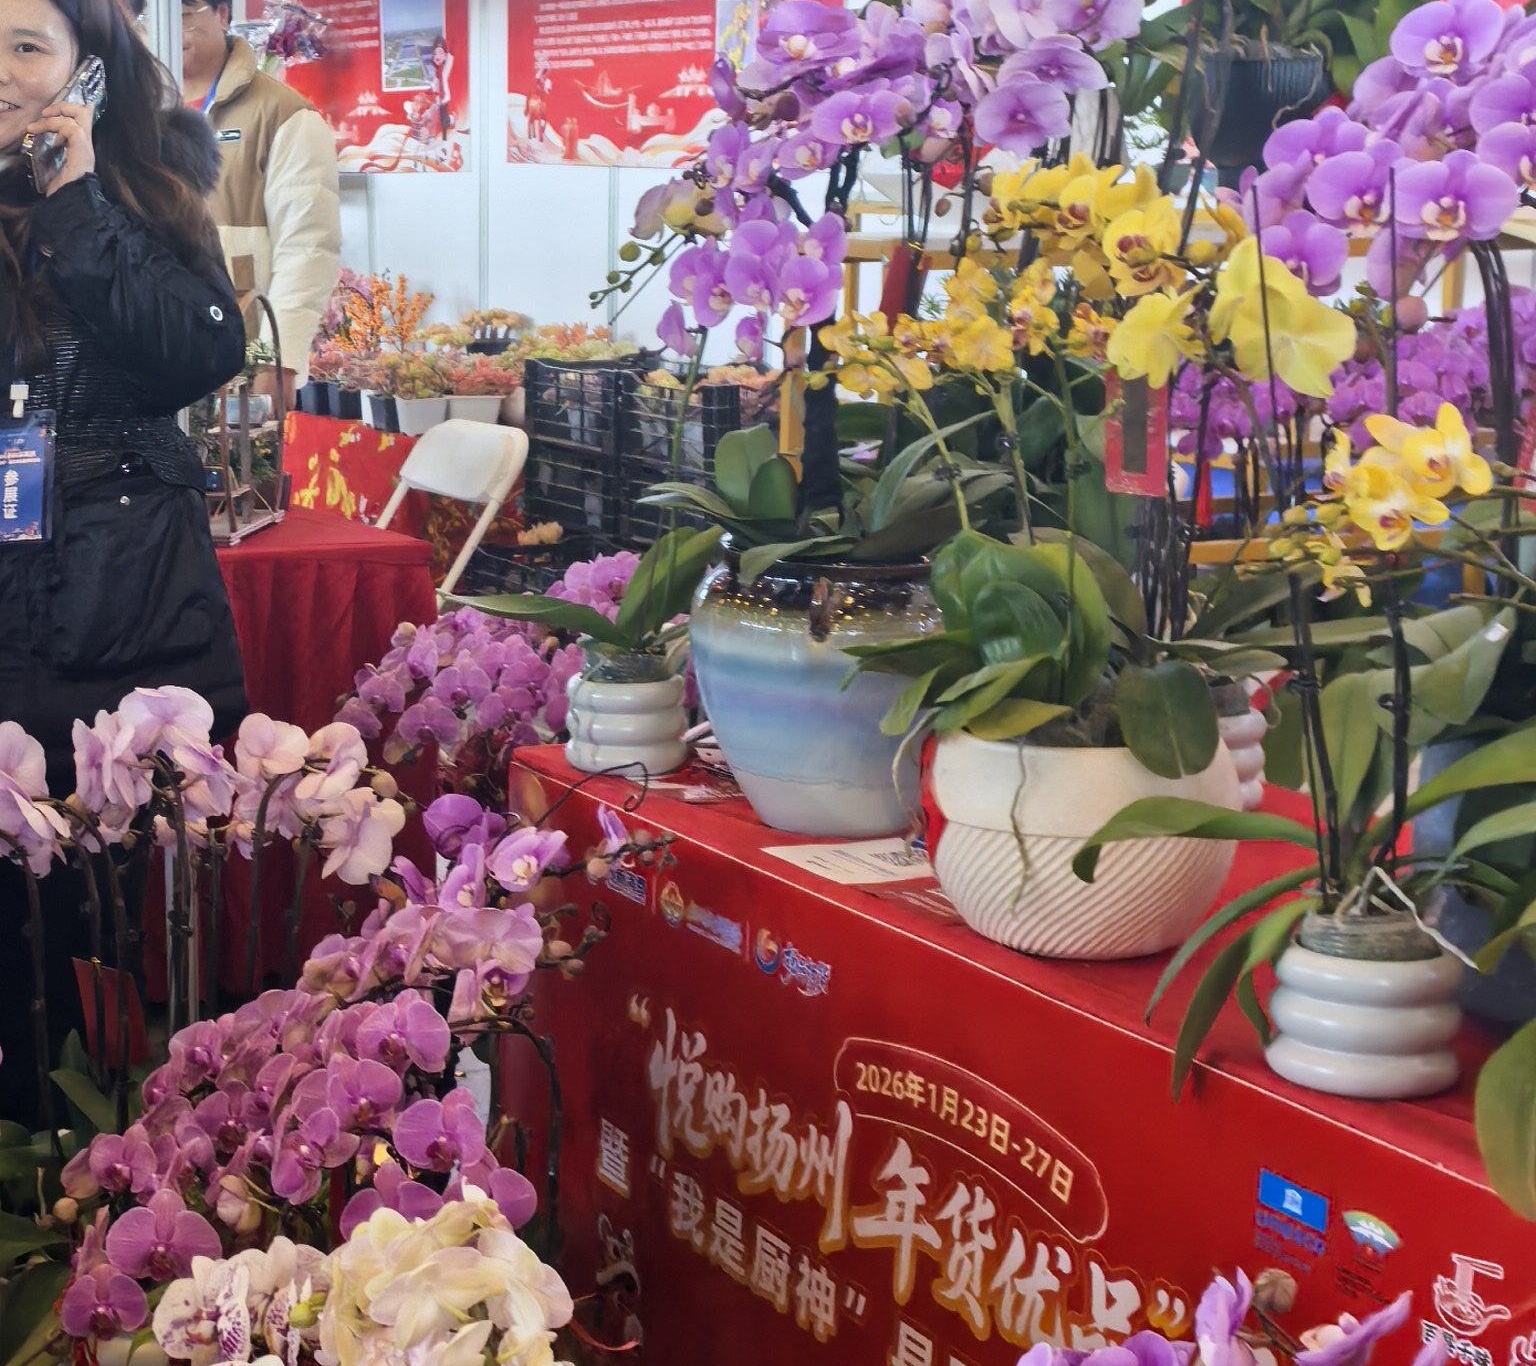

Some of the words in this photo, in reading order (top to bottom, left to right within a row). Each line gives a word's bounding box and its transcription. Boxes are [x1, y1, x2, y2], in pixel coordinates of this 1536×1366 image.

[599, 1117, 631, 1197] 暨
[855, 1062, 1075, 1205] 2026年1月23日-27日
